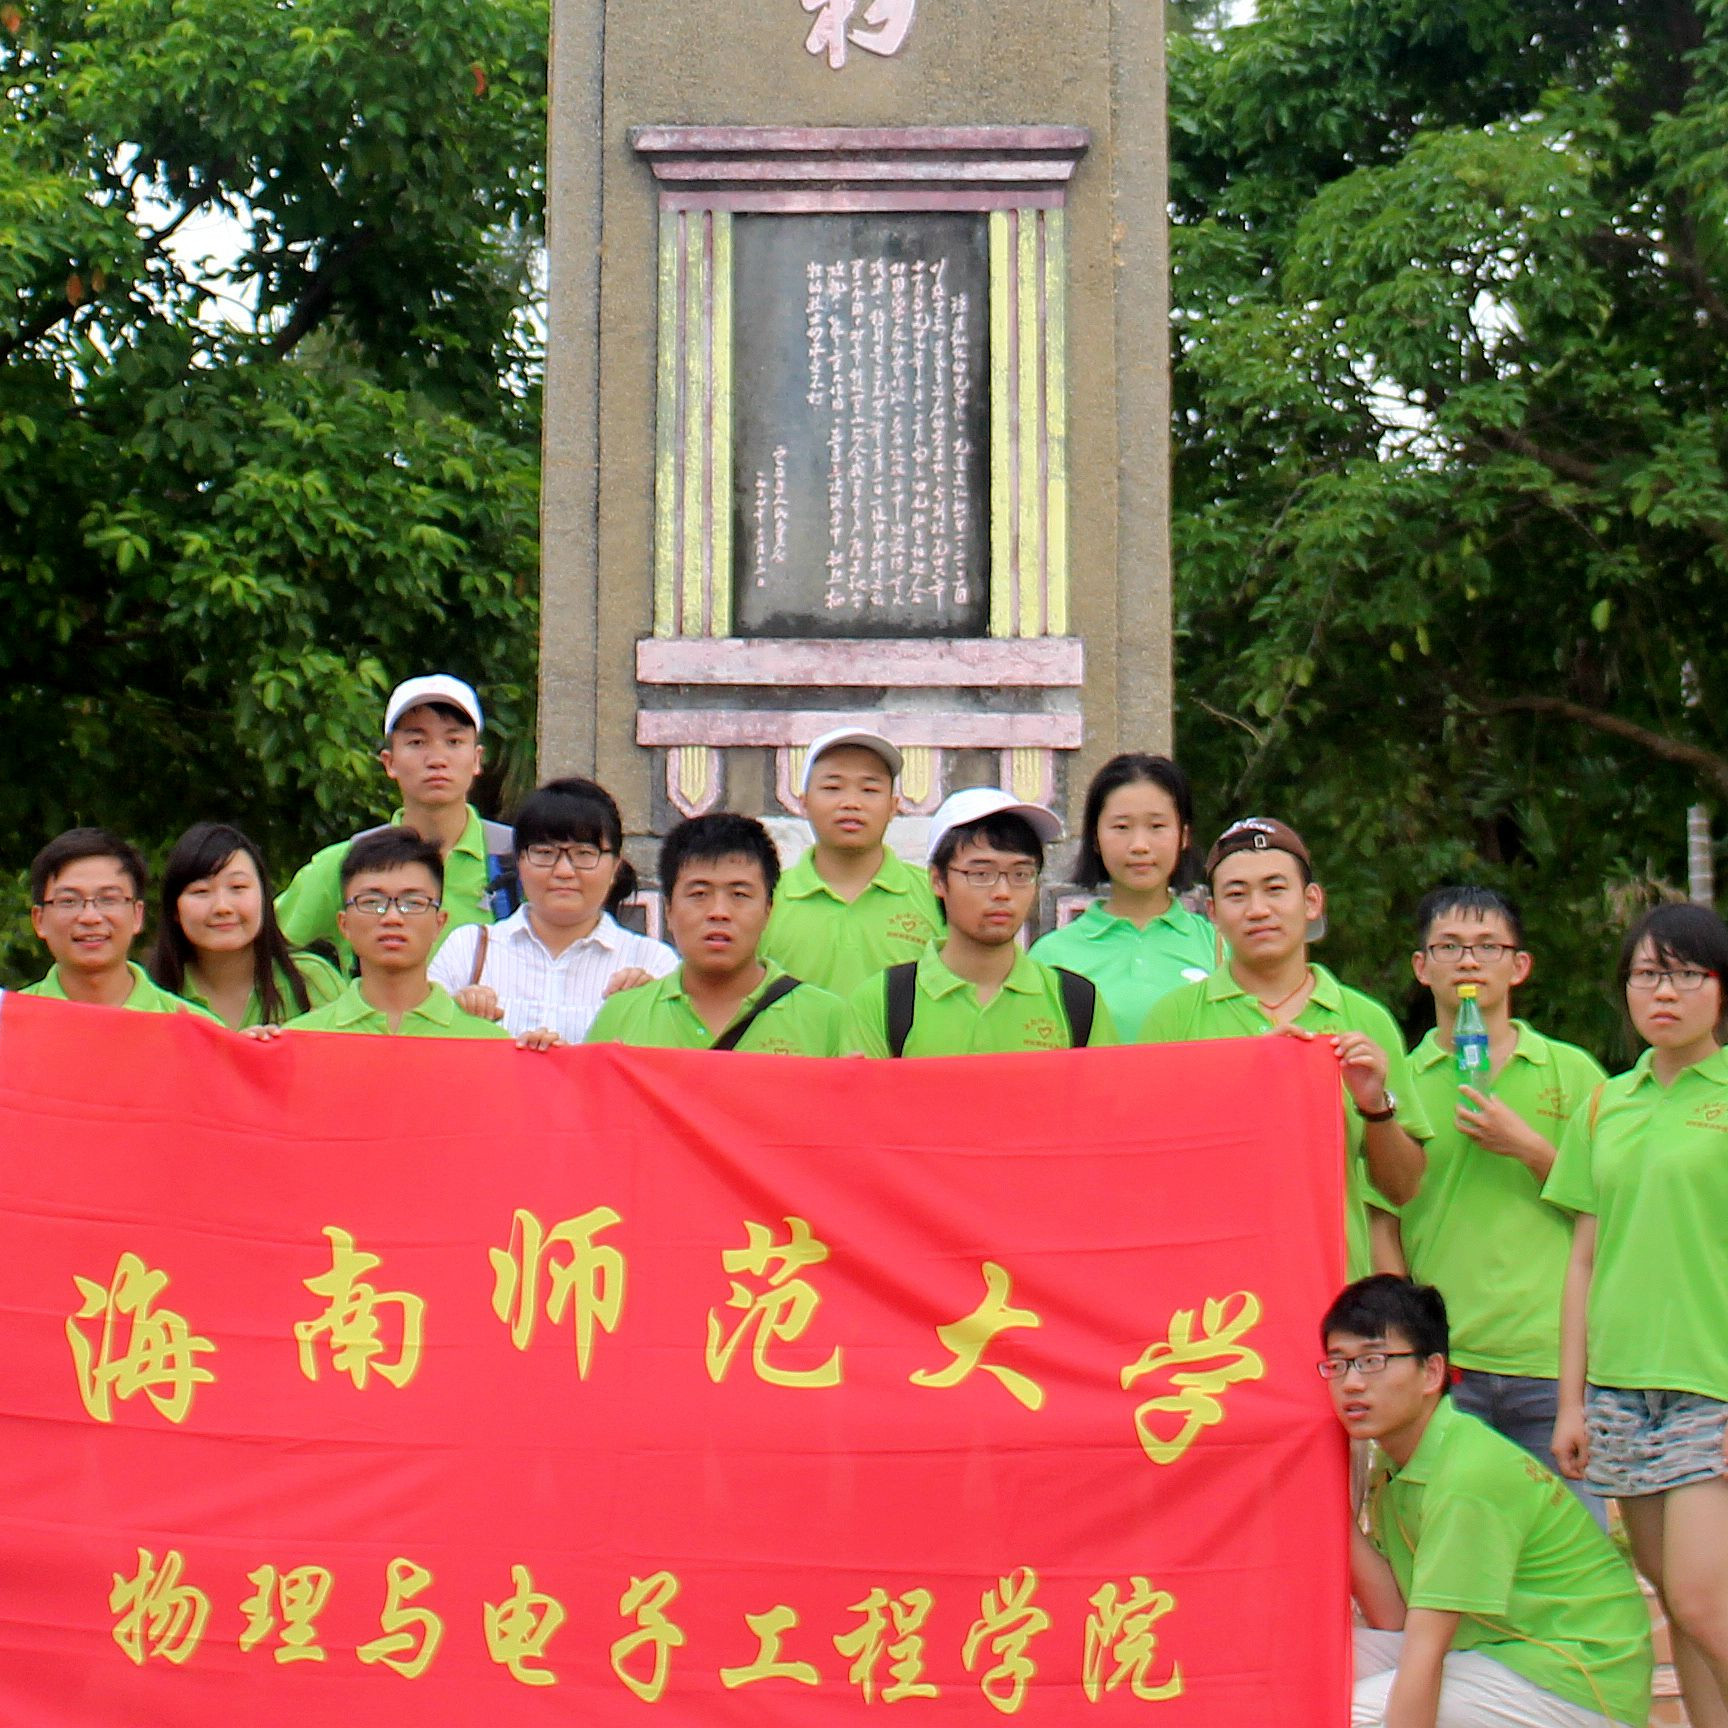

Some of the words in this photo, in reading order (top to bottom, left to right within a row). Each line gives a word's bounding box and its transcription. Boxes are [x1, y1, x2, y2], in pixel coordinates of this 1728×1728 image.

[65, 1206, 1267, 1465] 海南师范大学
[108, 1547, 1185, 1715] 物理与电子工程学院
